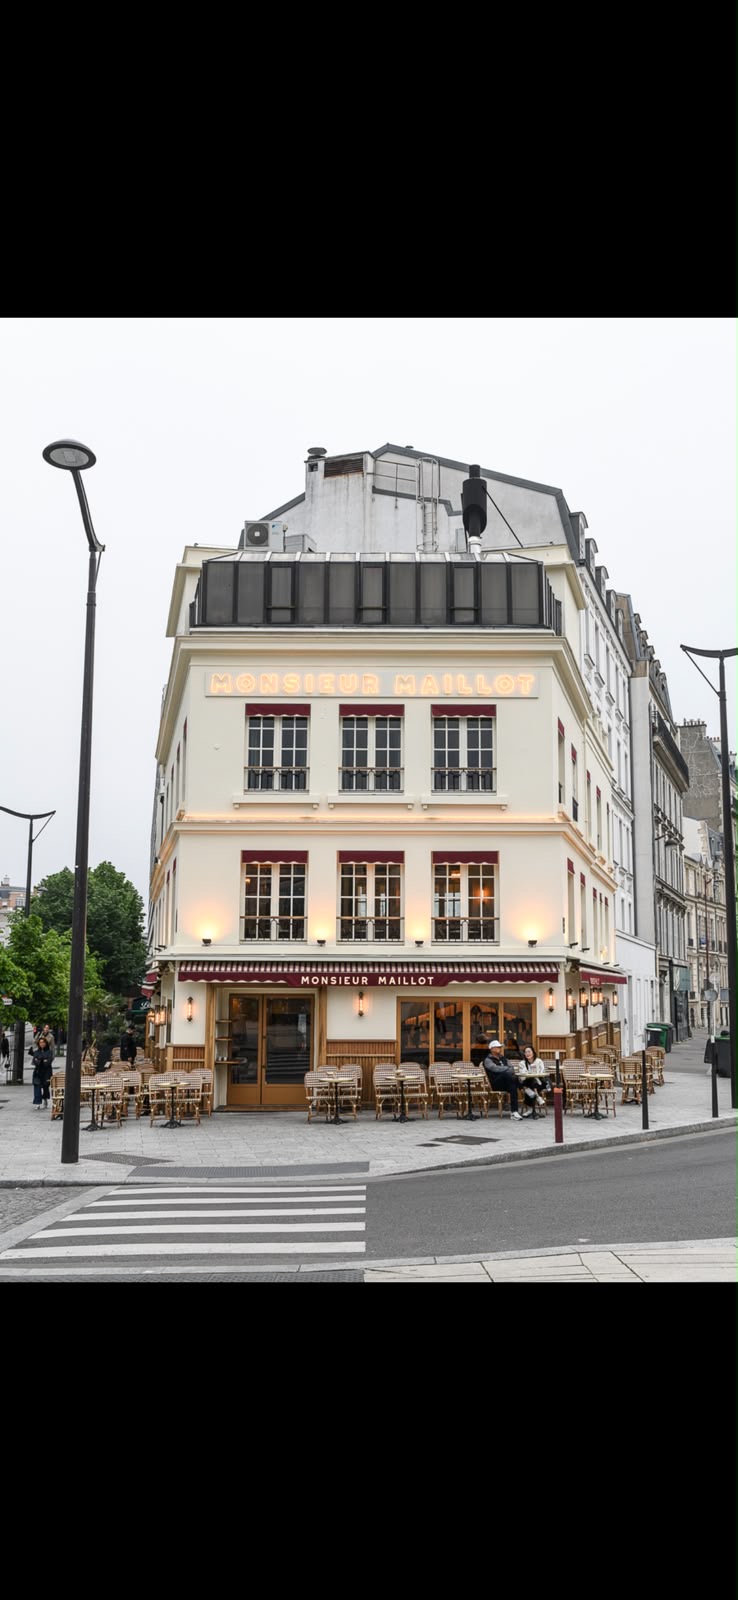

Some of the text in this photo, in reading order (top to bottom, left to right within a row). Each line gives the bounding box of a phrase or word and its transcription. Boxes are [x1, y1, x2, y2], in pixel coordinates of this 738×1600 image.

[210, 673, 536, 696] MONSIEUR MAILLOT
[301, 976, 435, 985] MONSIEUR MAILLOT
